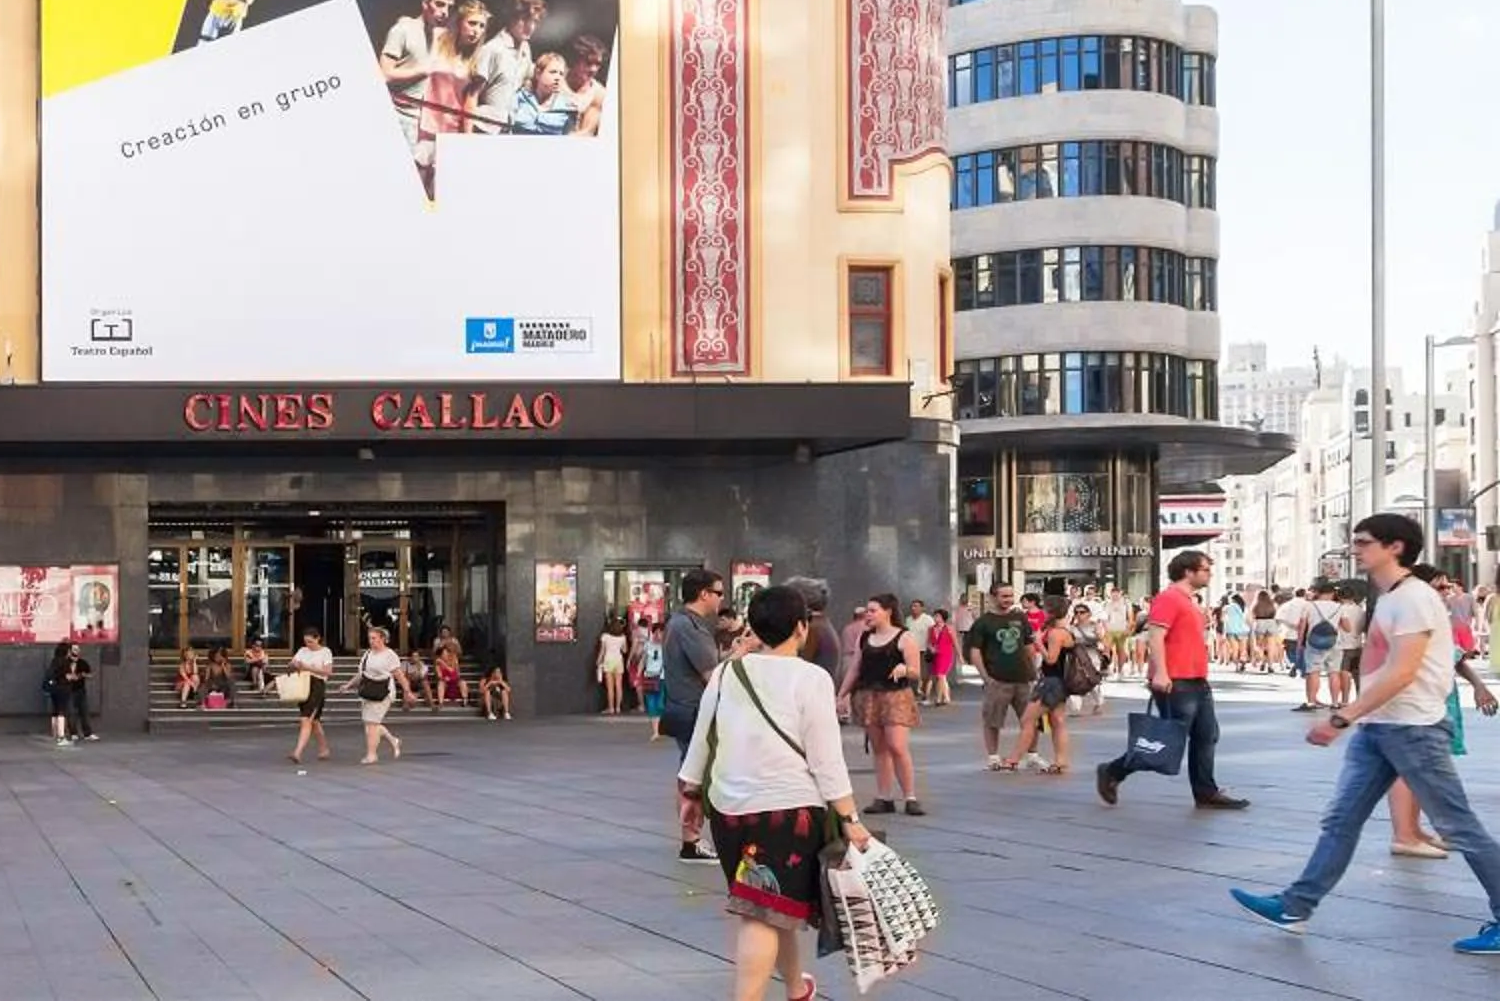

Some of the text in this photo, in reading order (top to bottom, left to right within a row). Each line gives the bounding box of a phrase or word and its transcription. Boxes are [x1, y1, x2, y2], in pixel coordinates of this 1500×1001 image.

[120, 74, 341, 159] Creación en grupo
[522, 329, 587, 341] MATADERO
[70, 346, 153, 357] Teatro Español
[184, 392, 564, 432] CINES CALLAO
